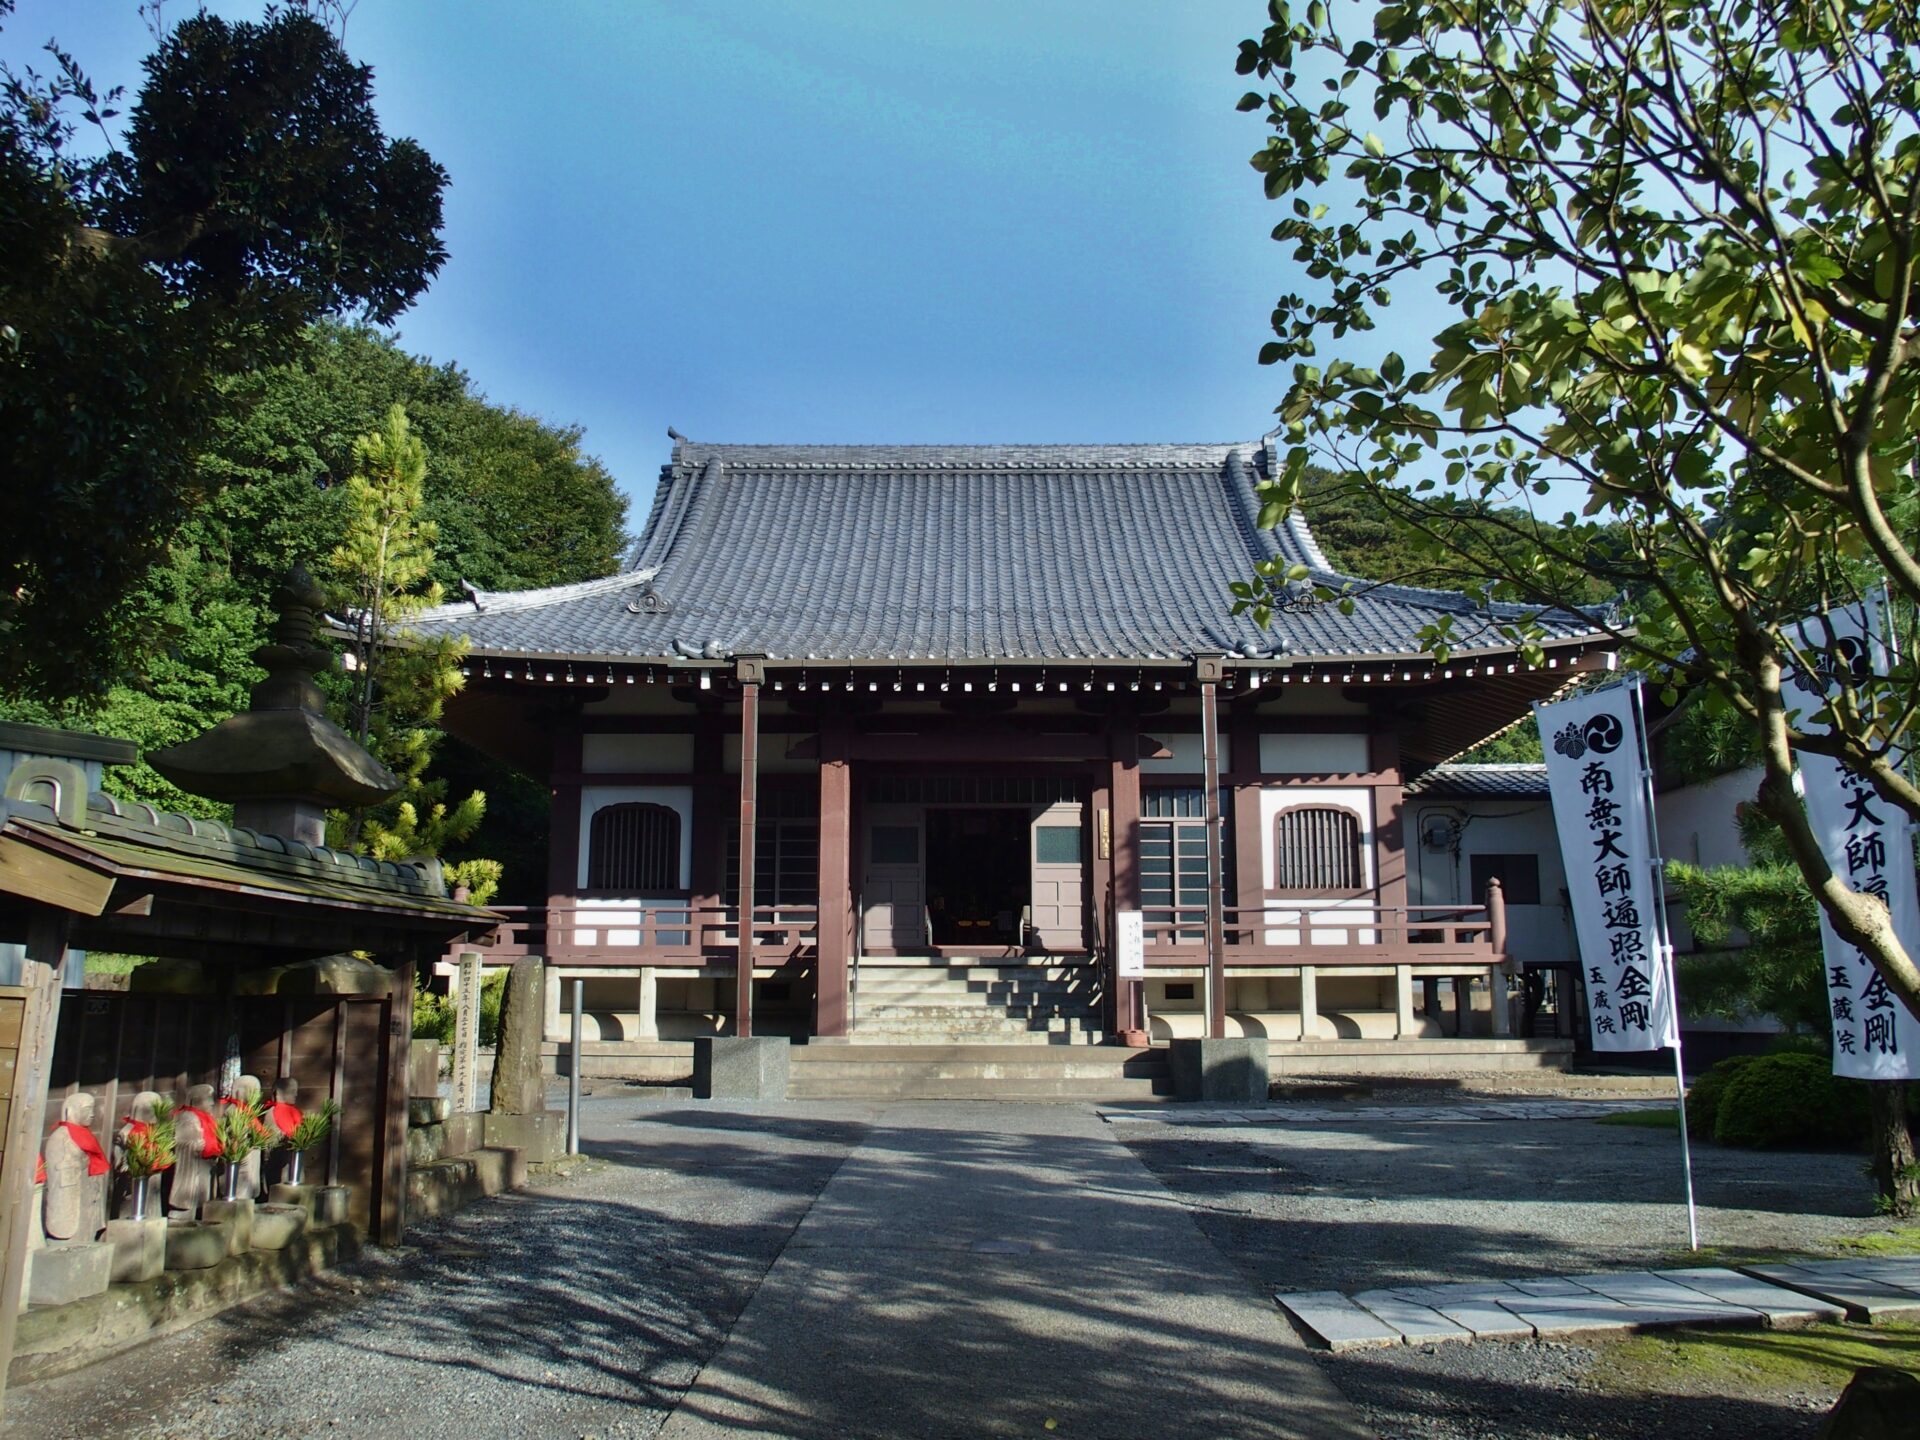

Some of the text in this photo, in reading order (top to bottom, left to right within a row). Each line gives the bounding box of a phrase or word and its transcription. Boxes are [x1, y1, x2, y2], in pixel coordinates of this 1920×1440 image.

[1580, 761, 1652, 1031] 南無大師遍照金剛
[1589, 966, 1616, 1034] 玉蔵院
[1829, 966, 1856, 1055] 玉蔵院
